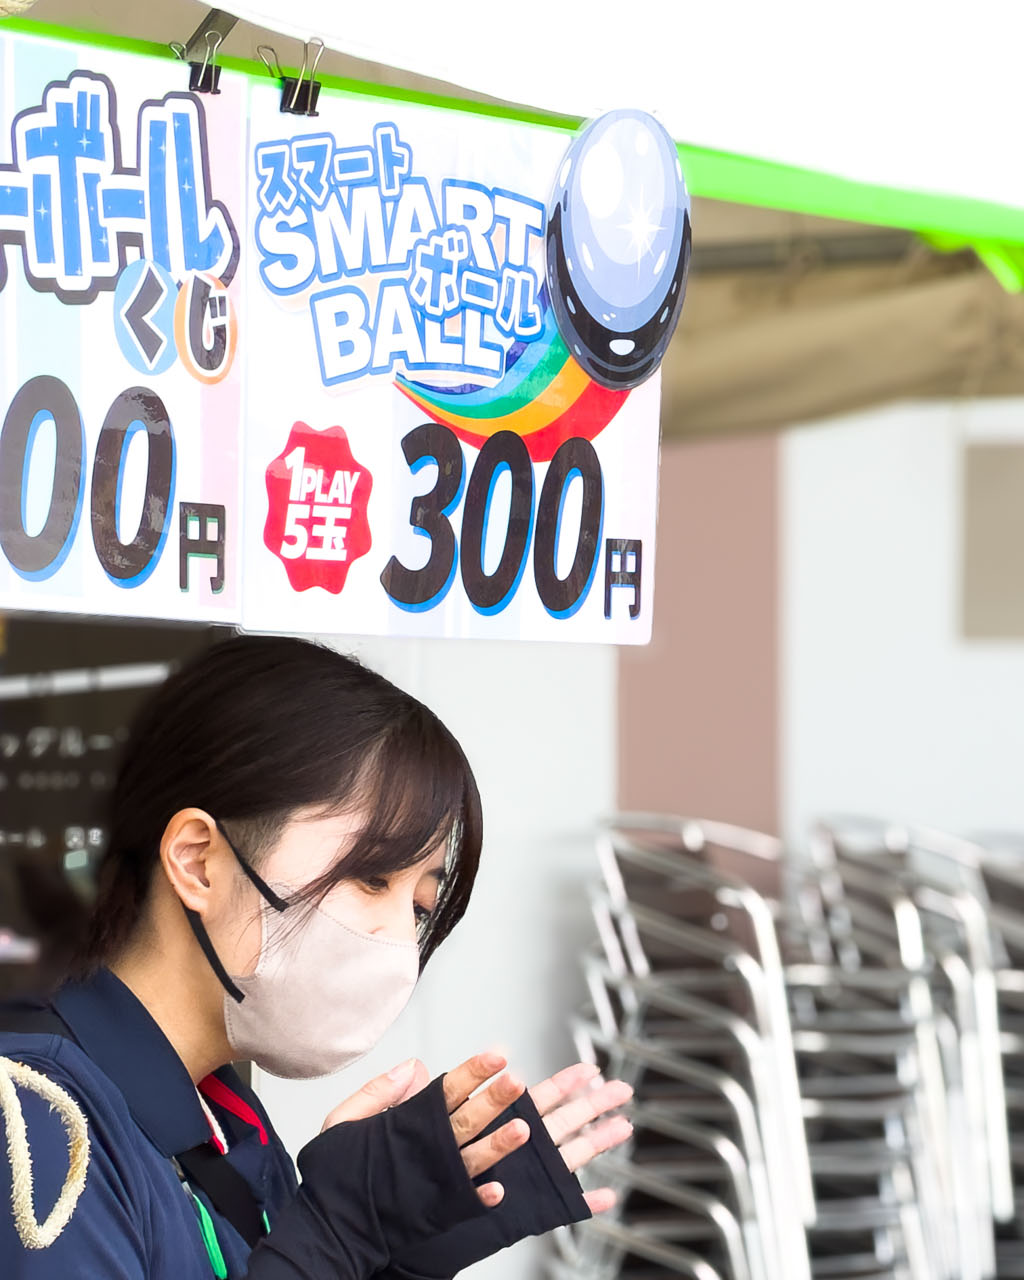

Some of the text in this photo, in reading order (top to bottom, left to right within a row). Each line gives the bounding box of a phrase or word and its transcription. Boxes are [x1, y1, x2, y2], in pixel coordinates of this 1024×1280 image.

[254, 123, 413, 212] スマート
[256, 178, 545, 295] SMART
[410, 225, 545, 338] ボール
[122, 262, 228, 374] くじ
[310, 280, 505, 386] BALL
[280, 503, 352, 561] 5玉
